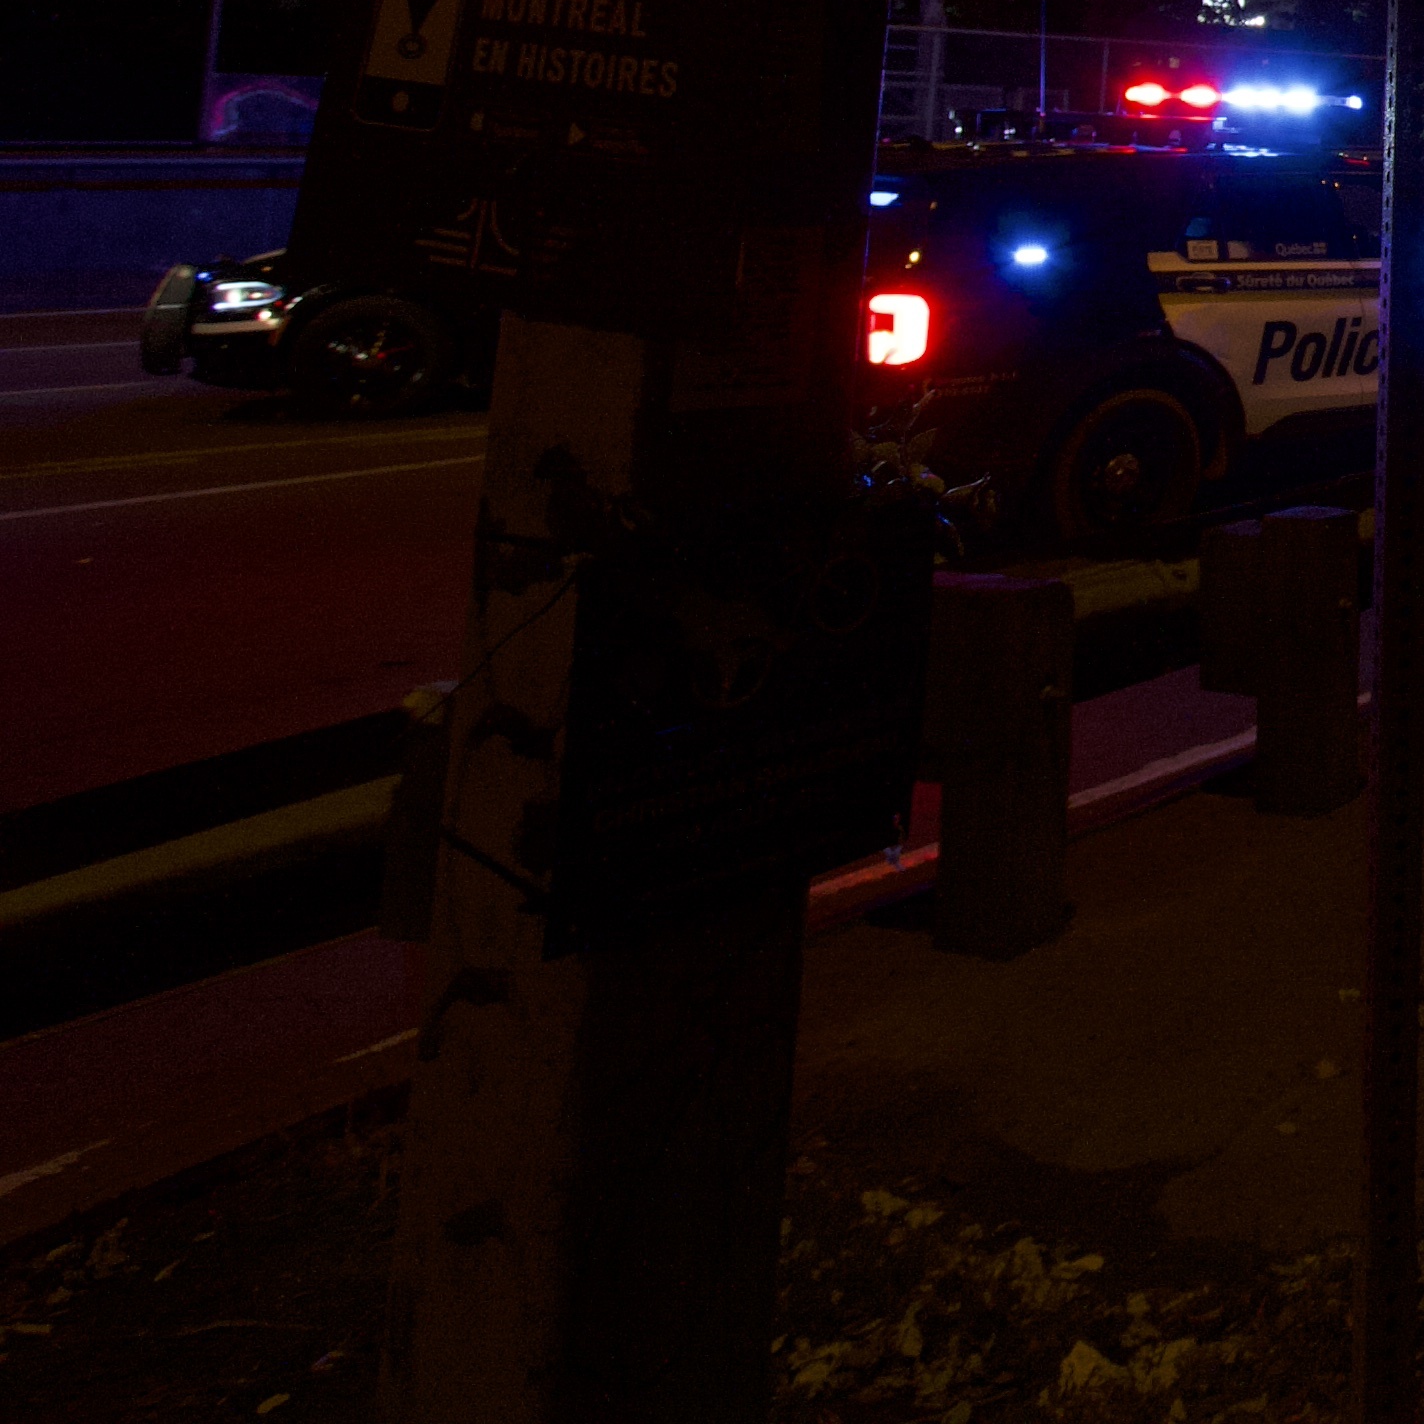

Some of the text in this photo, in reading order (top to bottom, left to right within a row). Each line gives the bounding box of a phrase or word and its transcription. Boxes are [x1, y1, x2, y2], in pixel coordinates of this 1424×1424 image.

[473, 38, 679, 99] EN HISTOIRES
[1275, 242, 1314, 257] Québec
[1236, 272, 1355, 289] Sûreté du Québec
[1252, 317, 1382, 385] Polic
